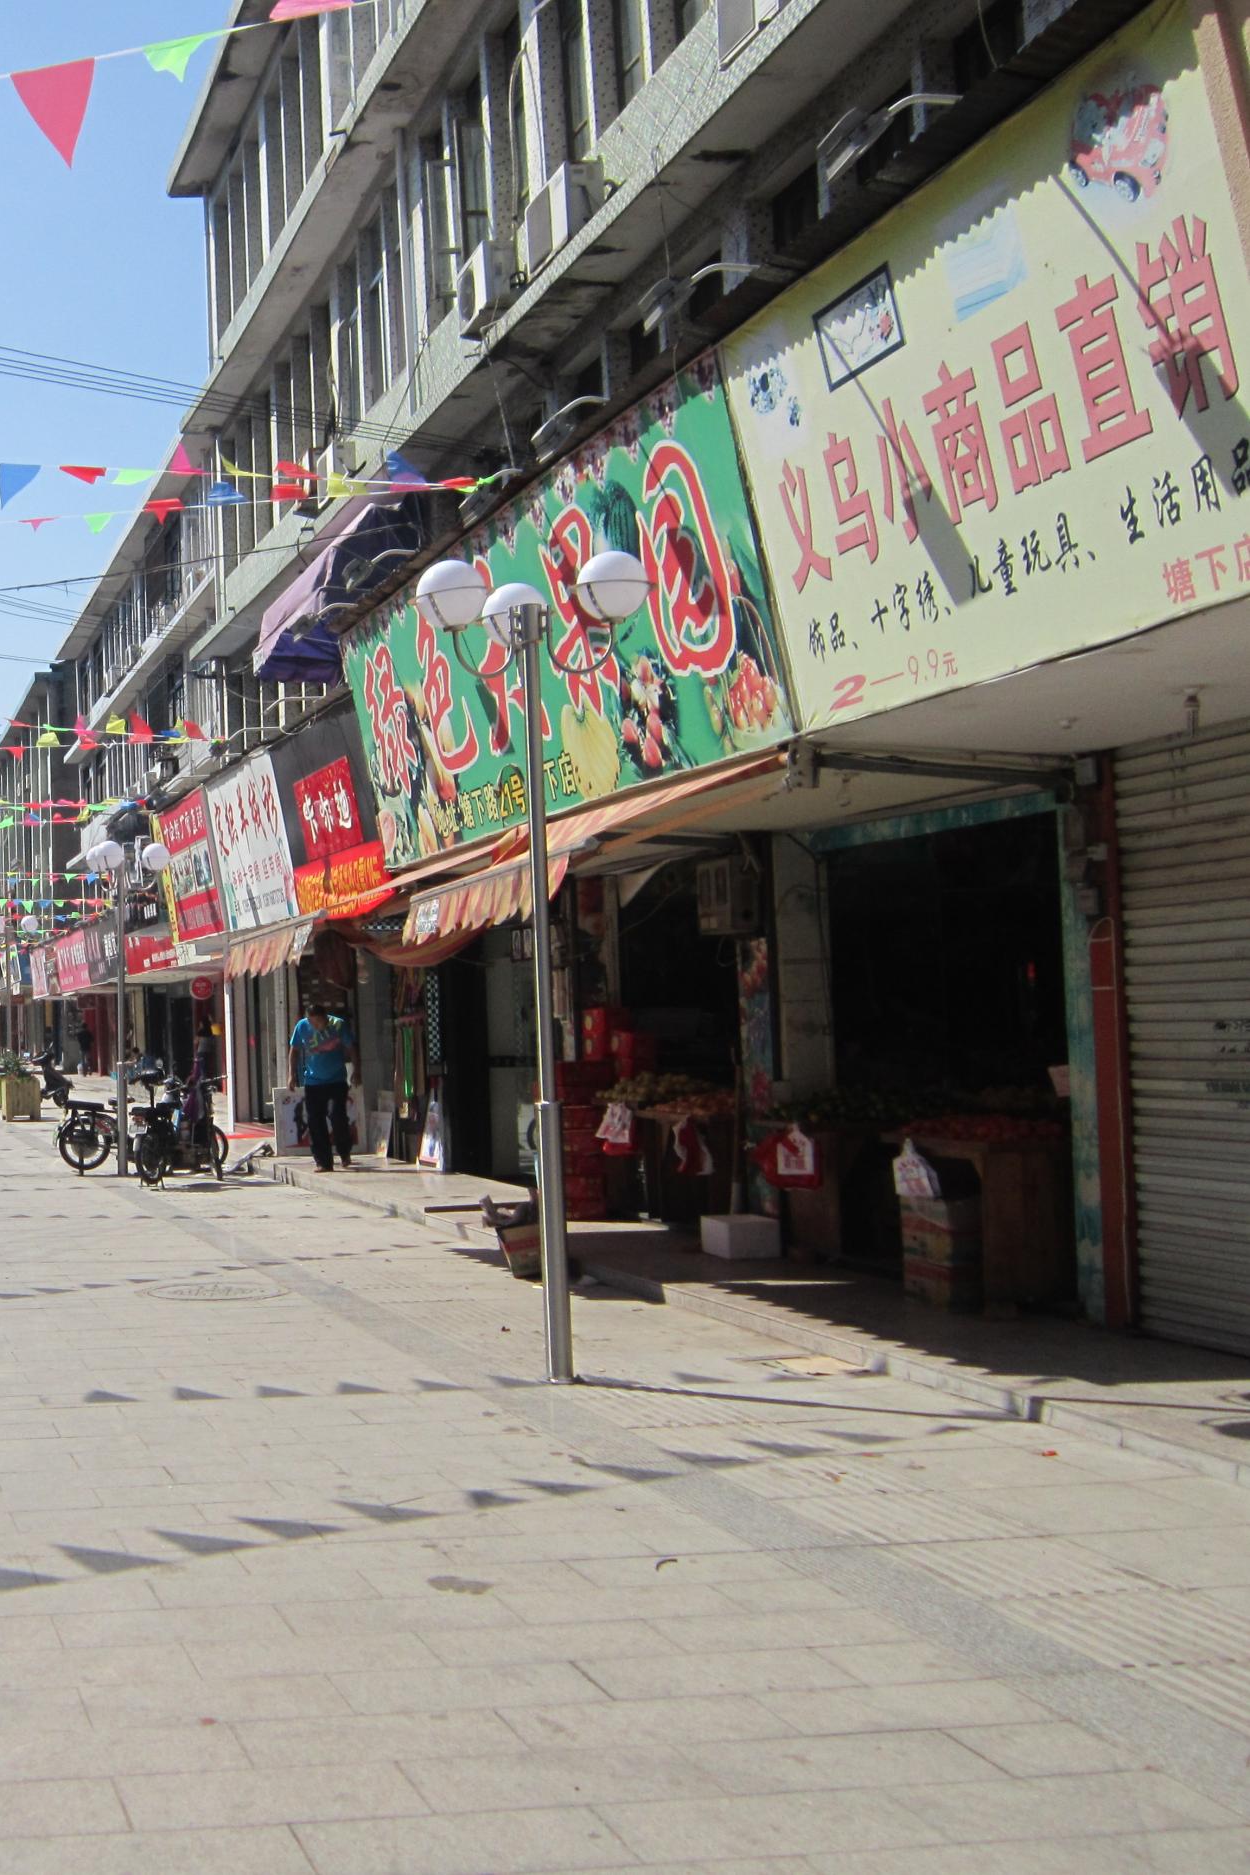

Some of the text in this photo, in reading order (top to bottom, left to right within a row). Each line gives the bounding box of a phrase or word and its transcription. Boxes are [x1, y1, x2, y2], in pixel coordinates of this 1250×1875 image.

[778, 213, 1240, 595] 义乌小商品直销
